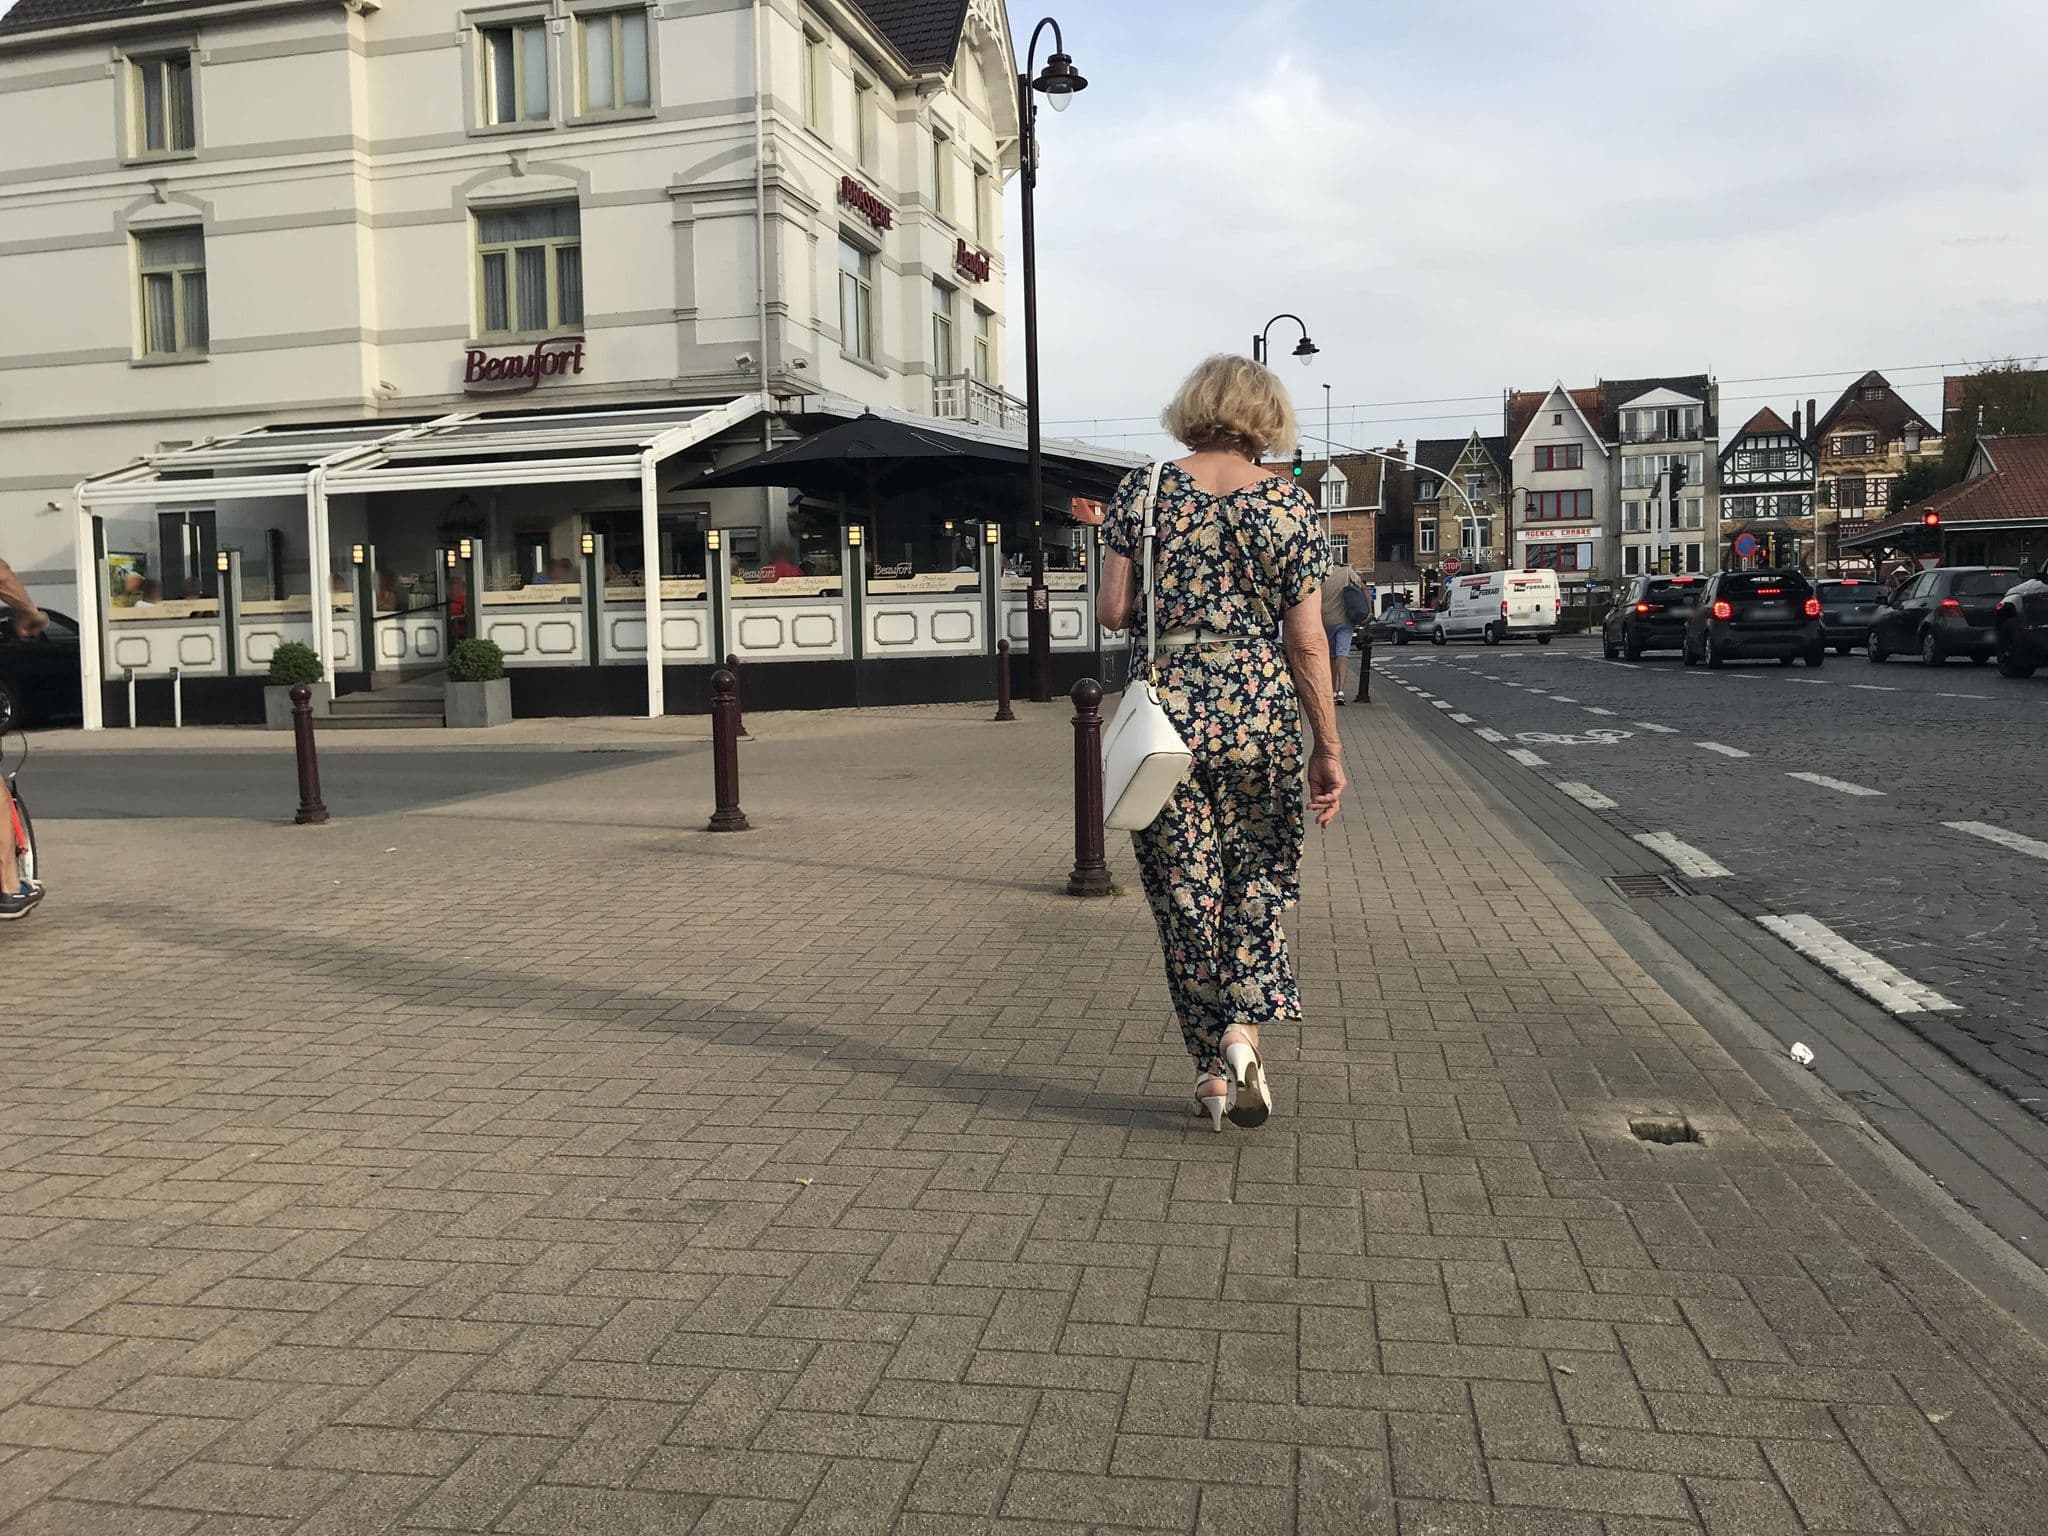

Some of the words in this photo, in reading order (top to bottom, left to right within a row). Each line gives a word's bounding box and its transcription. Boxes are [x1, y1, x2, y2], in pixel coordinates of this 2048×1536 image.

[463, 336, 586, 397] Beaufort
[738, 565, 777, 582] Beaufort
[873, 562, 913, 578] Beaufort
[1443, 561, 1460, 570] STOP
[1479, 587, 1500, 596] FERRARI
